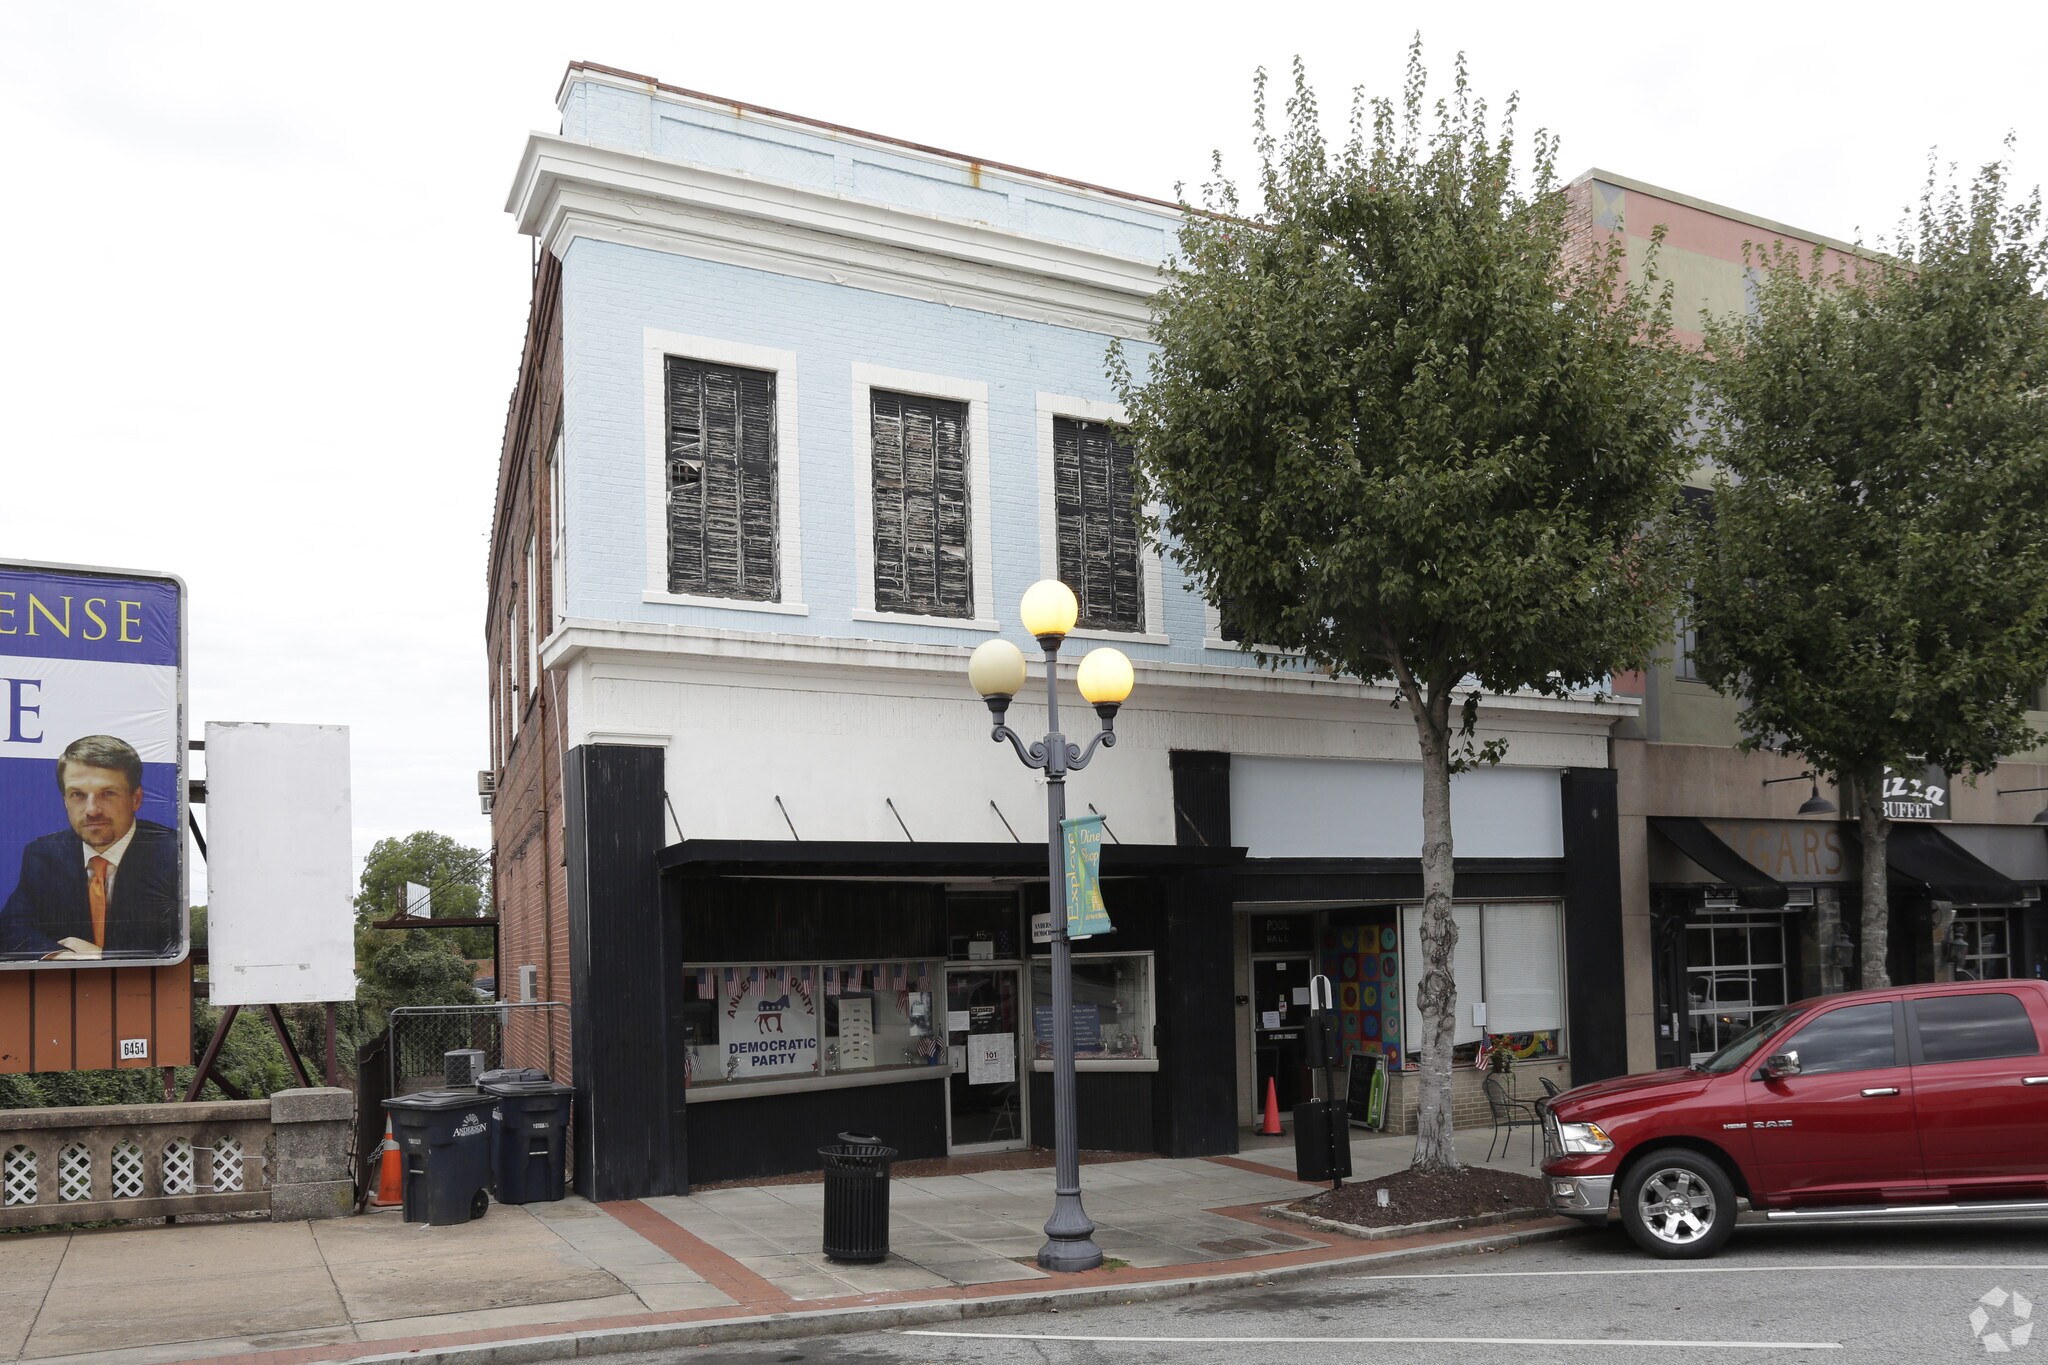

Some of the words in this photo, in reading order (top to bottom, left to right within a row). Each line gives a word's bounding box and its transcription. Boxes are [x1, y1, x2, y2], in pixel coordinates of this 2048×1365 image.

[1882, 766, 1946, 806] izza
[1882, 801, 1933, 819] BUFFET
[1080, 829, 1100, 845] Dine
[1710, 825, 1843, 875] IGARS
[1266, 920, 1290, 932] POOL
[1266, 934, 1289, 944] HALL
[790, 975, 815, 1016] OUNTY
[124, 1042, 145, 1056] 6454
[729, 1038, 816, 1055] DEMOCRATIC
[751, 1053, 796, 1067] PARTY
[452, 1122, 487, 1137] ANDERSON
[1753, 1119, 1793, 1129] RAM
